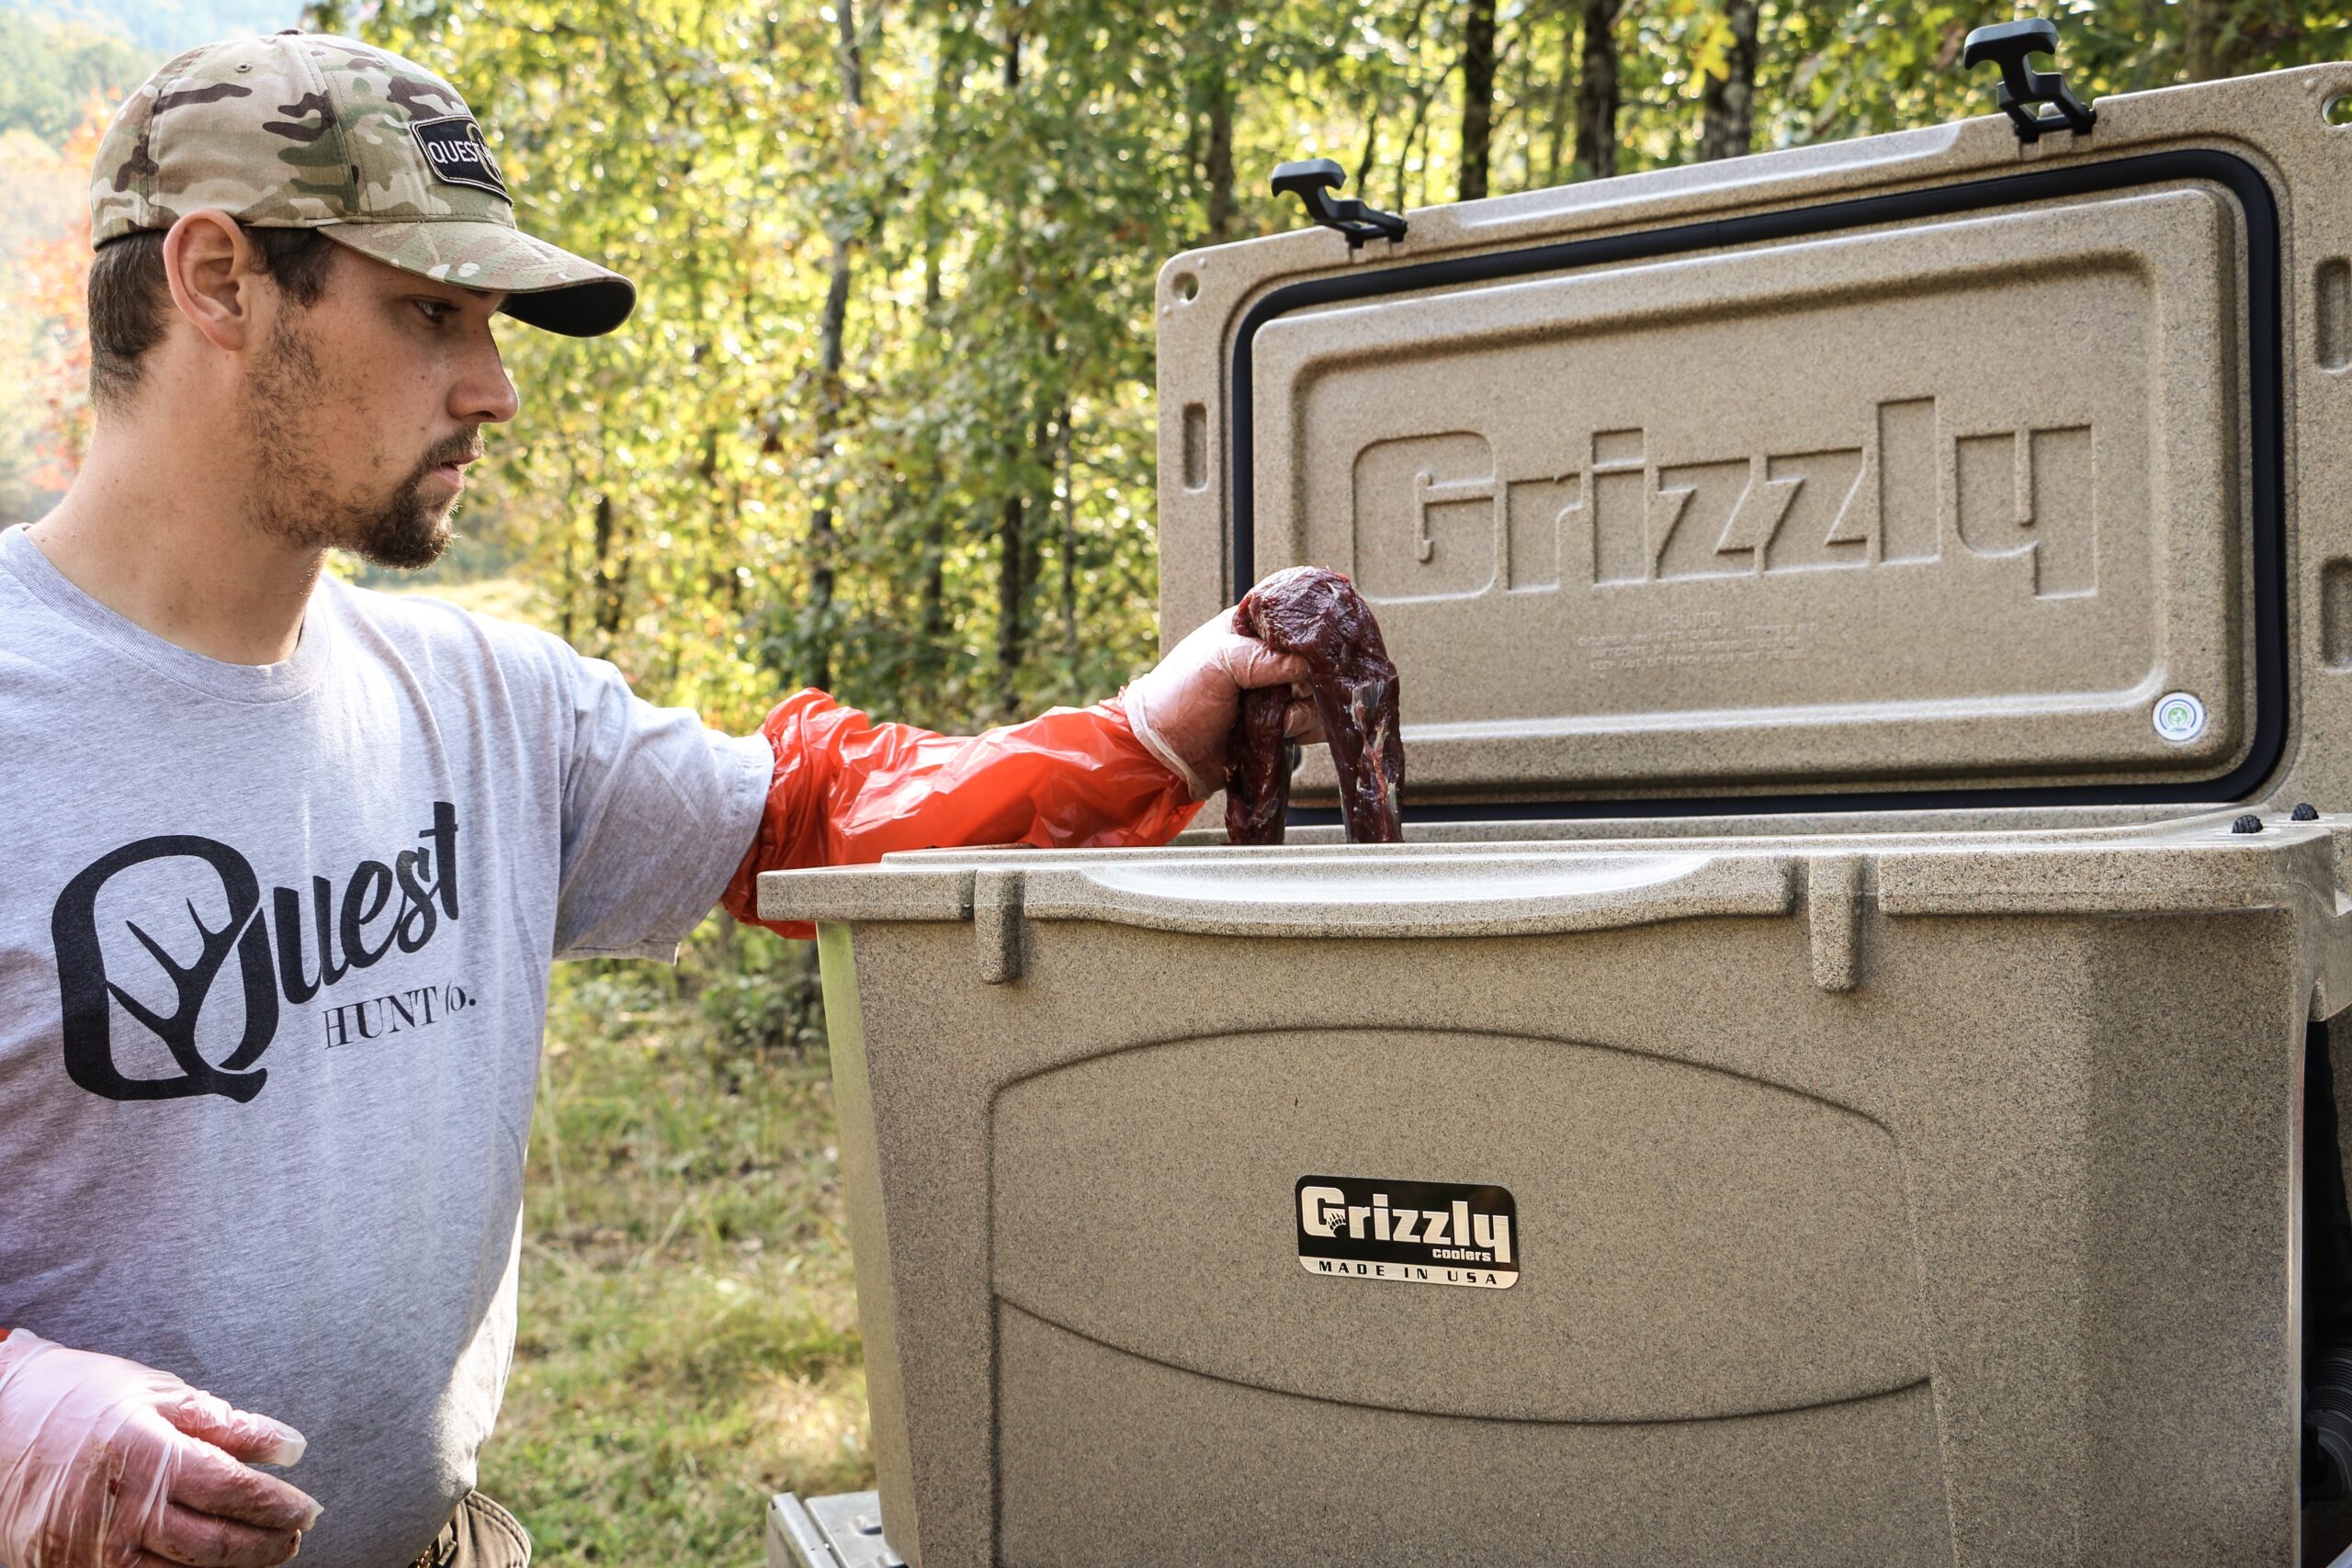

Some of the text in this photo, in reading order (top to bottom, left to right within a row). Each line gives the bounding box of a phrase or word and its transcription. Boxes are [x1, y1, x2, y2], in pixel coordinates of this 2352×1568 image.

[427, 141, 483, 164] QUEST
[1351, 395, 2099, 604] Grizzly
[51, 801, 458, 1103] Quest
[322, 985, 439, 1050] HUNT
[1301, 1186, 1511, 1263] Grizzly
[1432, 1248, 1492, 1262] coolers
[1318, 1260, 1498, 1285] MADE IN USA
